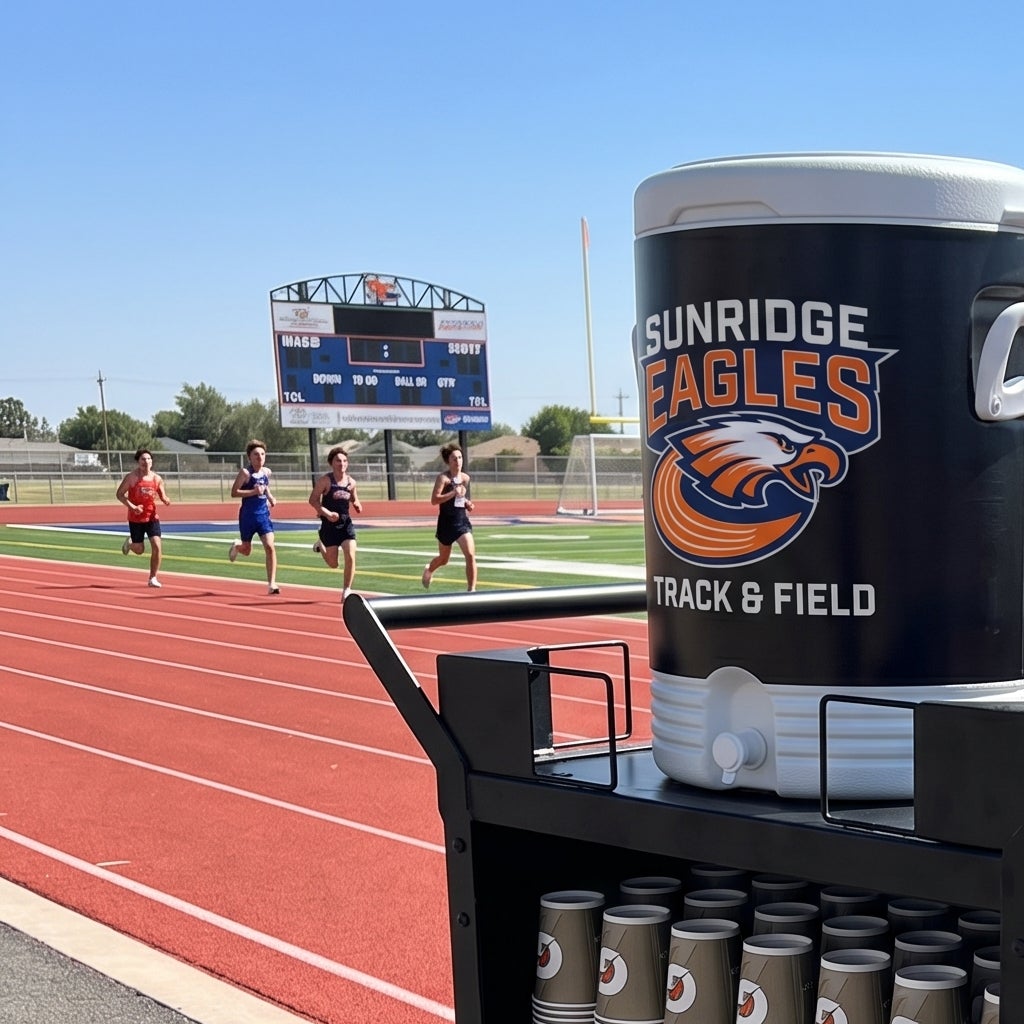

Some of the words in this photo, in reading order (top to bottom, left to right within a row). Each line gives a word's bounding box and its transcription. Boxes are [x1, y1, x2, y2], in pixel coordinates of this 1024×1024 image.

[645, 298, 869, 353] SUNRIDGE
[645, 348, 871, 438] EAGLES
[653, 575, 733, 613] TRACK
[741, 581, 764, 614] &
[774, 582, 876, 617] FIELD
